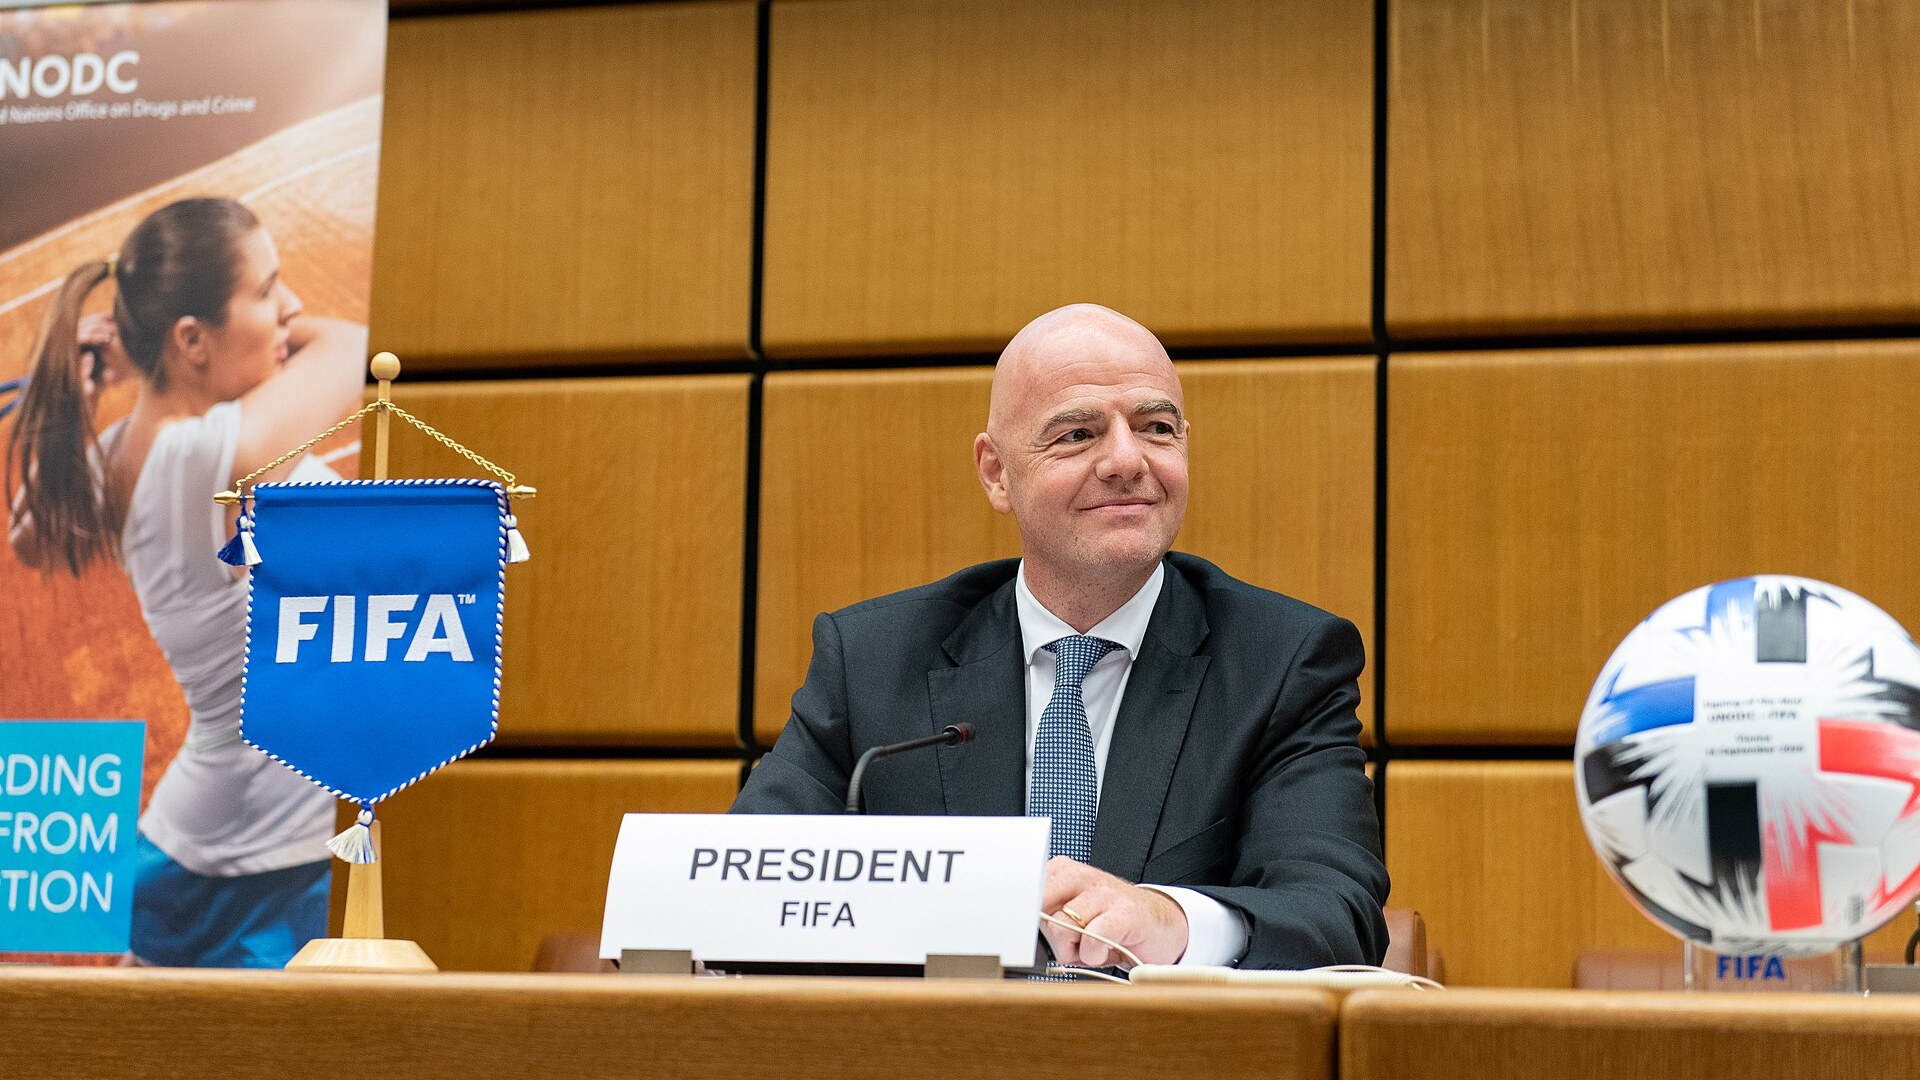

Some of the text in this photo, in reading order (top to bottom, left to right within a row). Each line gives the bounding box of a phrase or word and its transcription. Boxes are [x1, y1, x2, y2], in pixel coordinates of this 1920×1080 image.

[0, 50, 140, 99] NODC
[10, 104, 63, 124] Nations
[65, 100, 109, 120] Office
[110, 102, 131, 119] on
[132, 98, 178, 121] Drugs
[180, 96, 210, 116] and
[210, 95, 256, 115] Crime
[275, 594, 474, 663] FIFA
[0, 753, 122, 797] DING
[689, 848, 965, 883] PRESIDENT
[1, 869, 113, 913] TION
[780, 901, 856, 928] FIFA
[1716, 954, 1786, 981] FIFA
